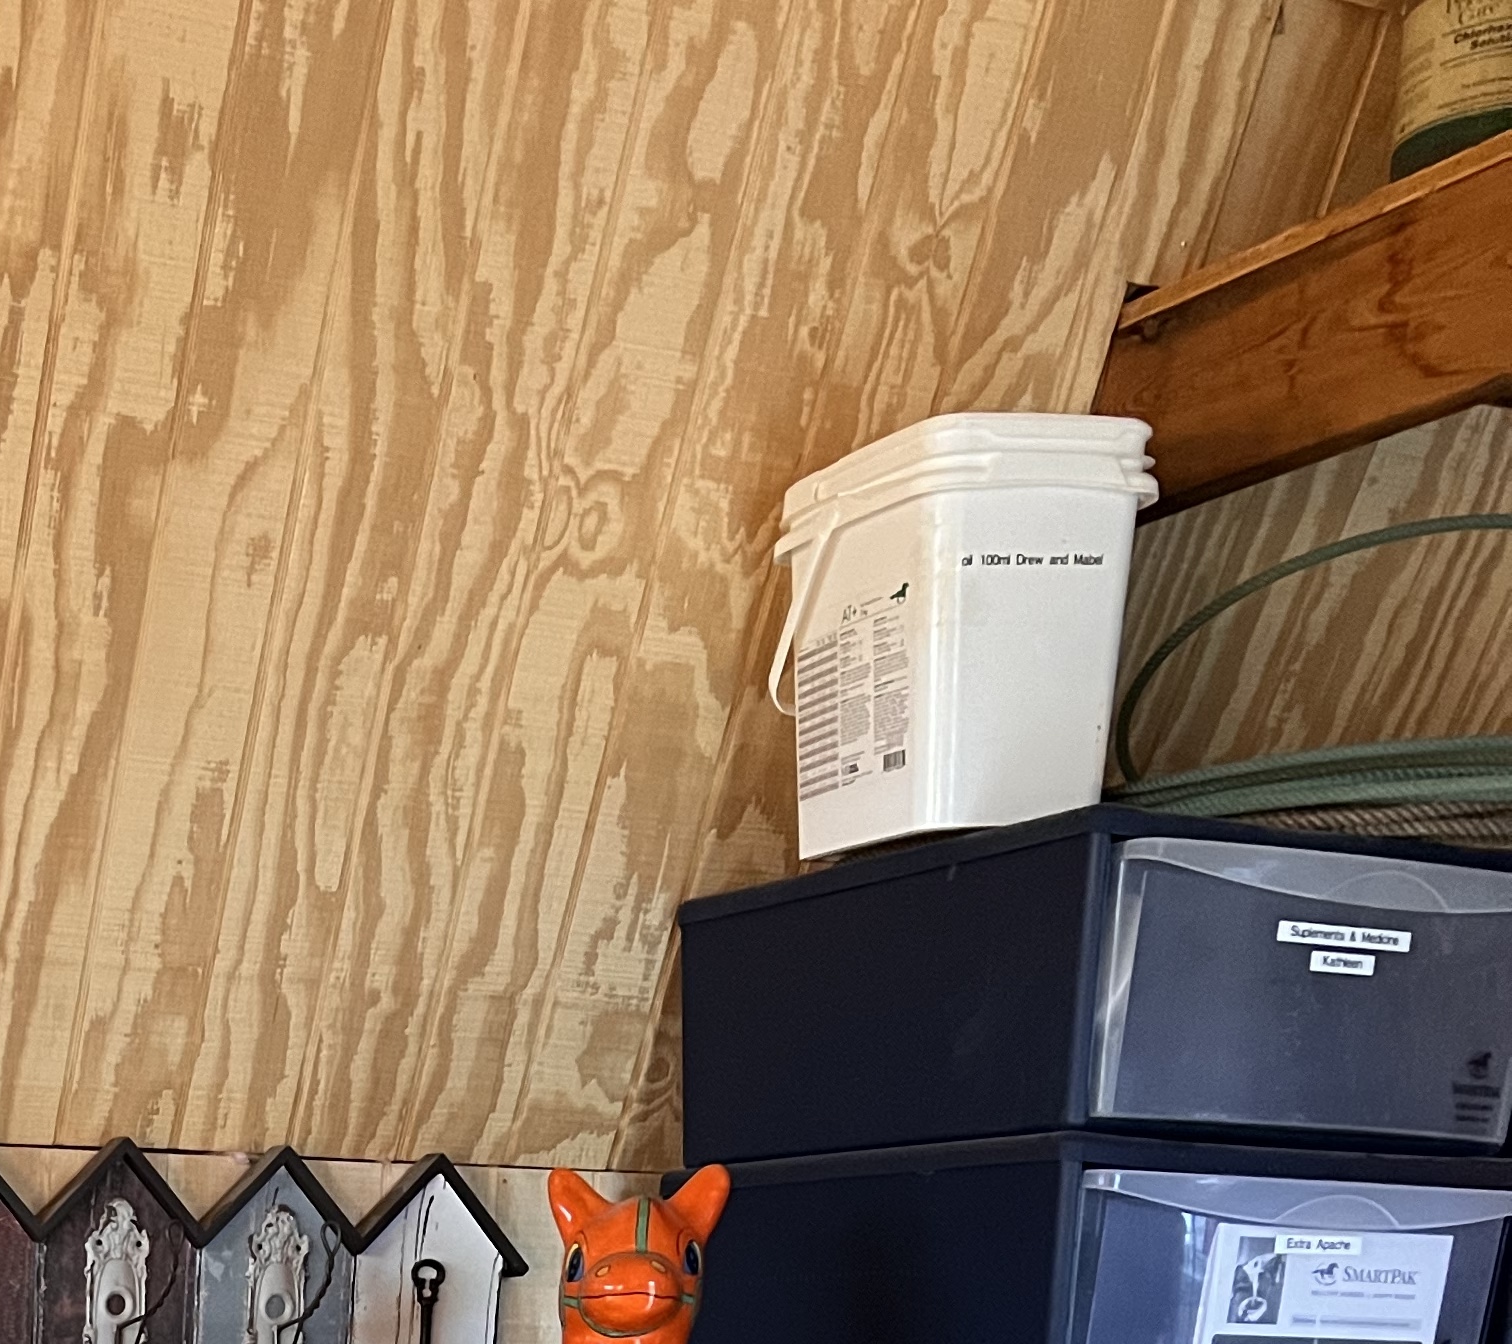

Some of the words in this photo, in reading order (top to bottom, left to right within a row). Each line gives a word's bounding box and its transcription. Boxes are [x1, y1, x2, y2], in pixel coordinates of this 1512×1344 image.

[981, 554, 1011, 566] 100ml
[1016, 554, 1043, 566] Drew
[1050, 554, 1069, 565] and
[1074, 554, 1104, 565] Mabel
[1350, 931, 1356, 941] &
[1287, 1238, 1311, 1250] Extra
[1316, 1239, 1351, 1250] Apache
